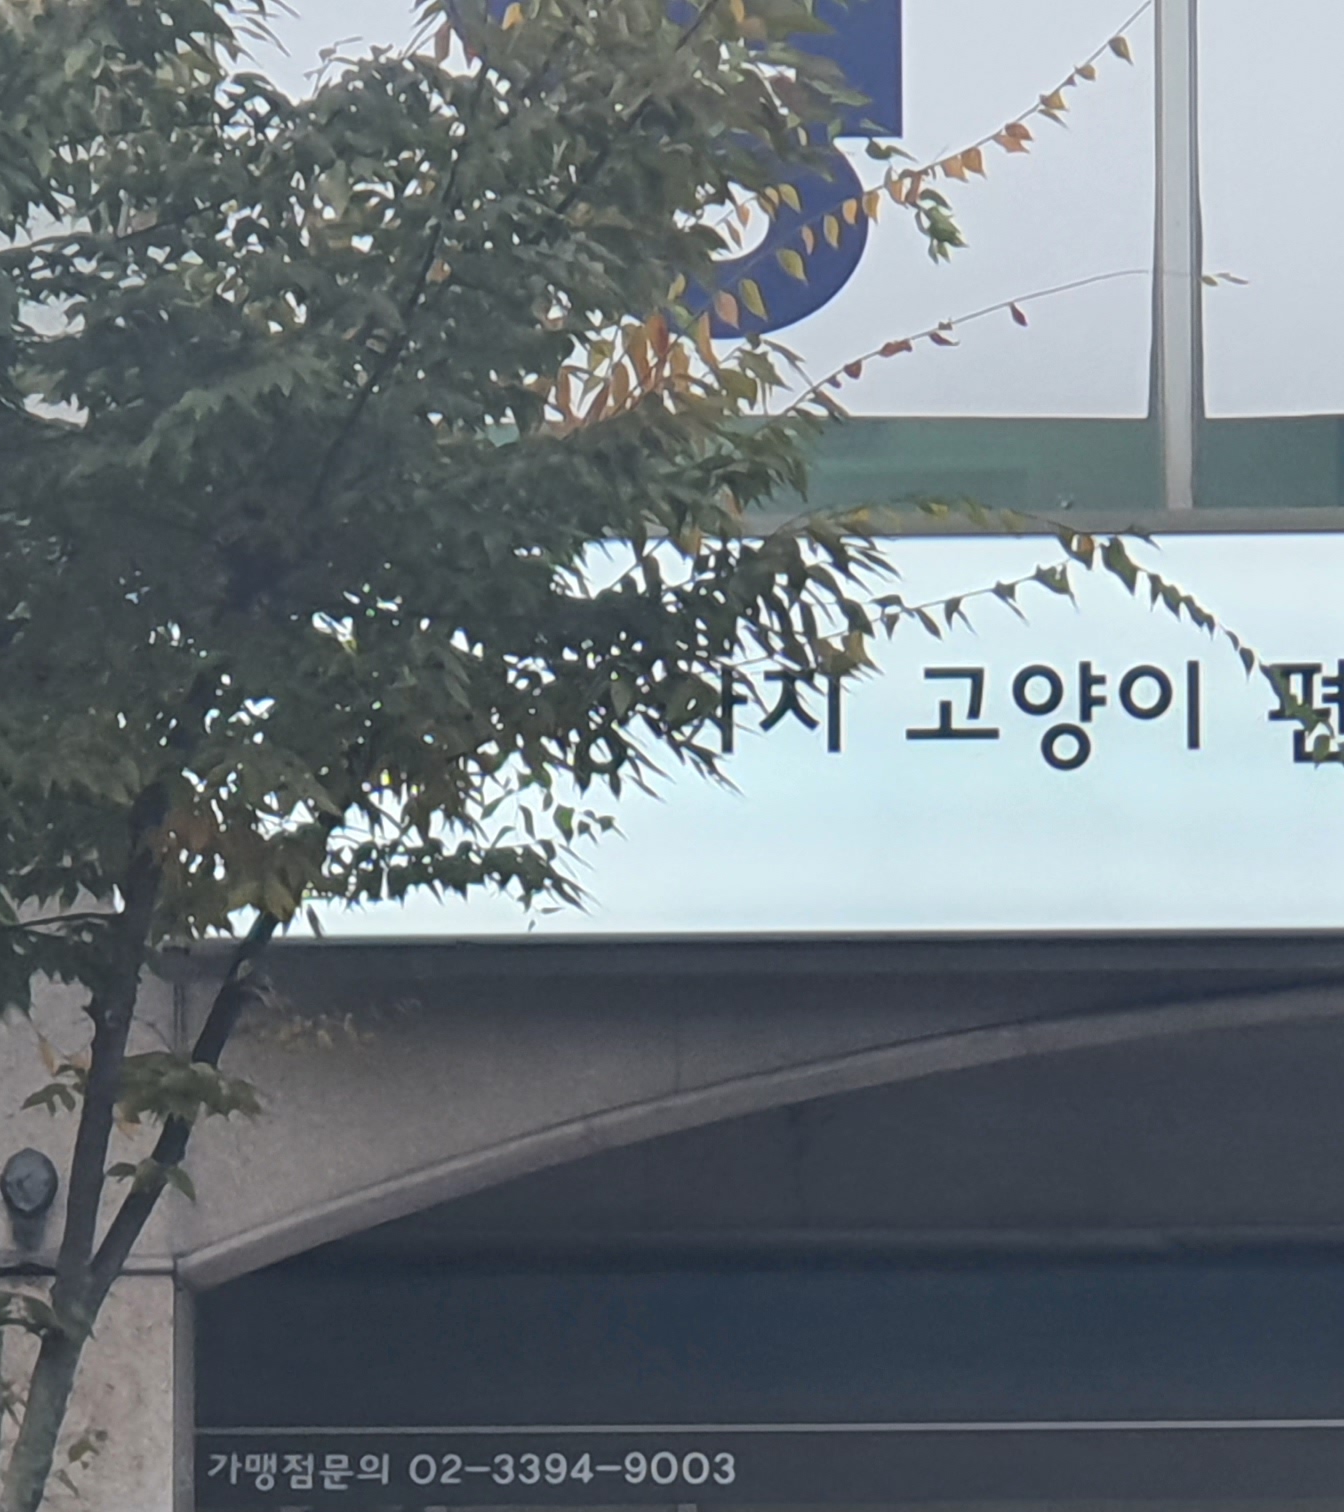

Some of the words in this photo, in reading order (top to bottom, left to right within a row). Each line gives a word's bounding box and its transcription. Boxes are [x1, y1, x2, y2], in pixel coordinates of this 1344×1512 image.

[902, 659, 1204, 772] 고양이
[207, 1453, 390, 1491] 가맹점문의
[408, 1451, 737, 1485] 02-3394-9003
